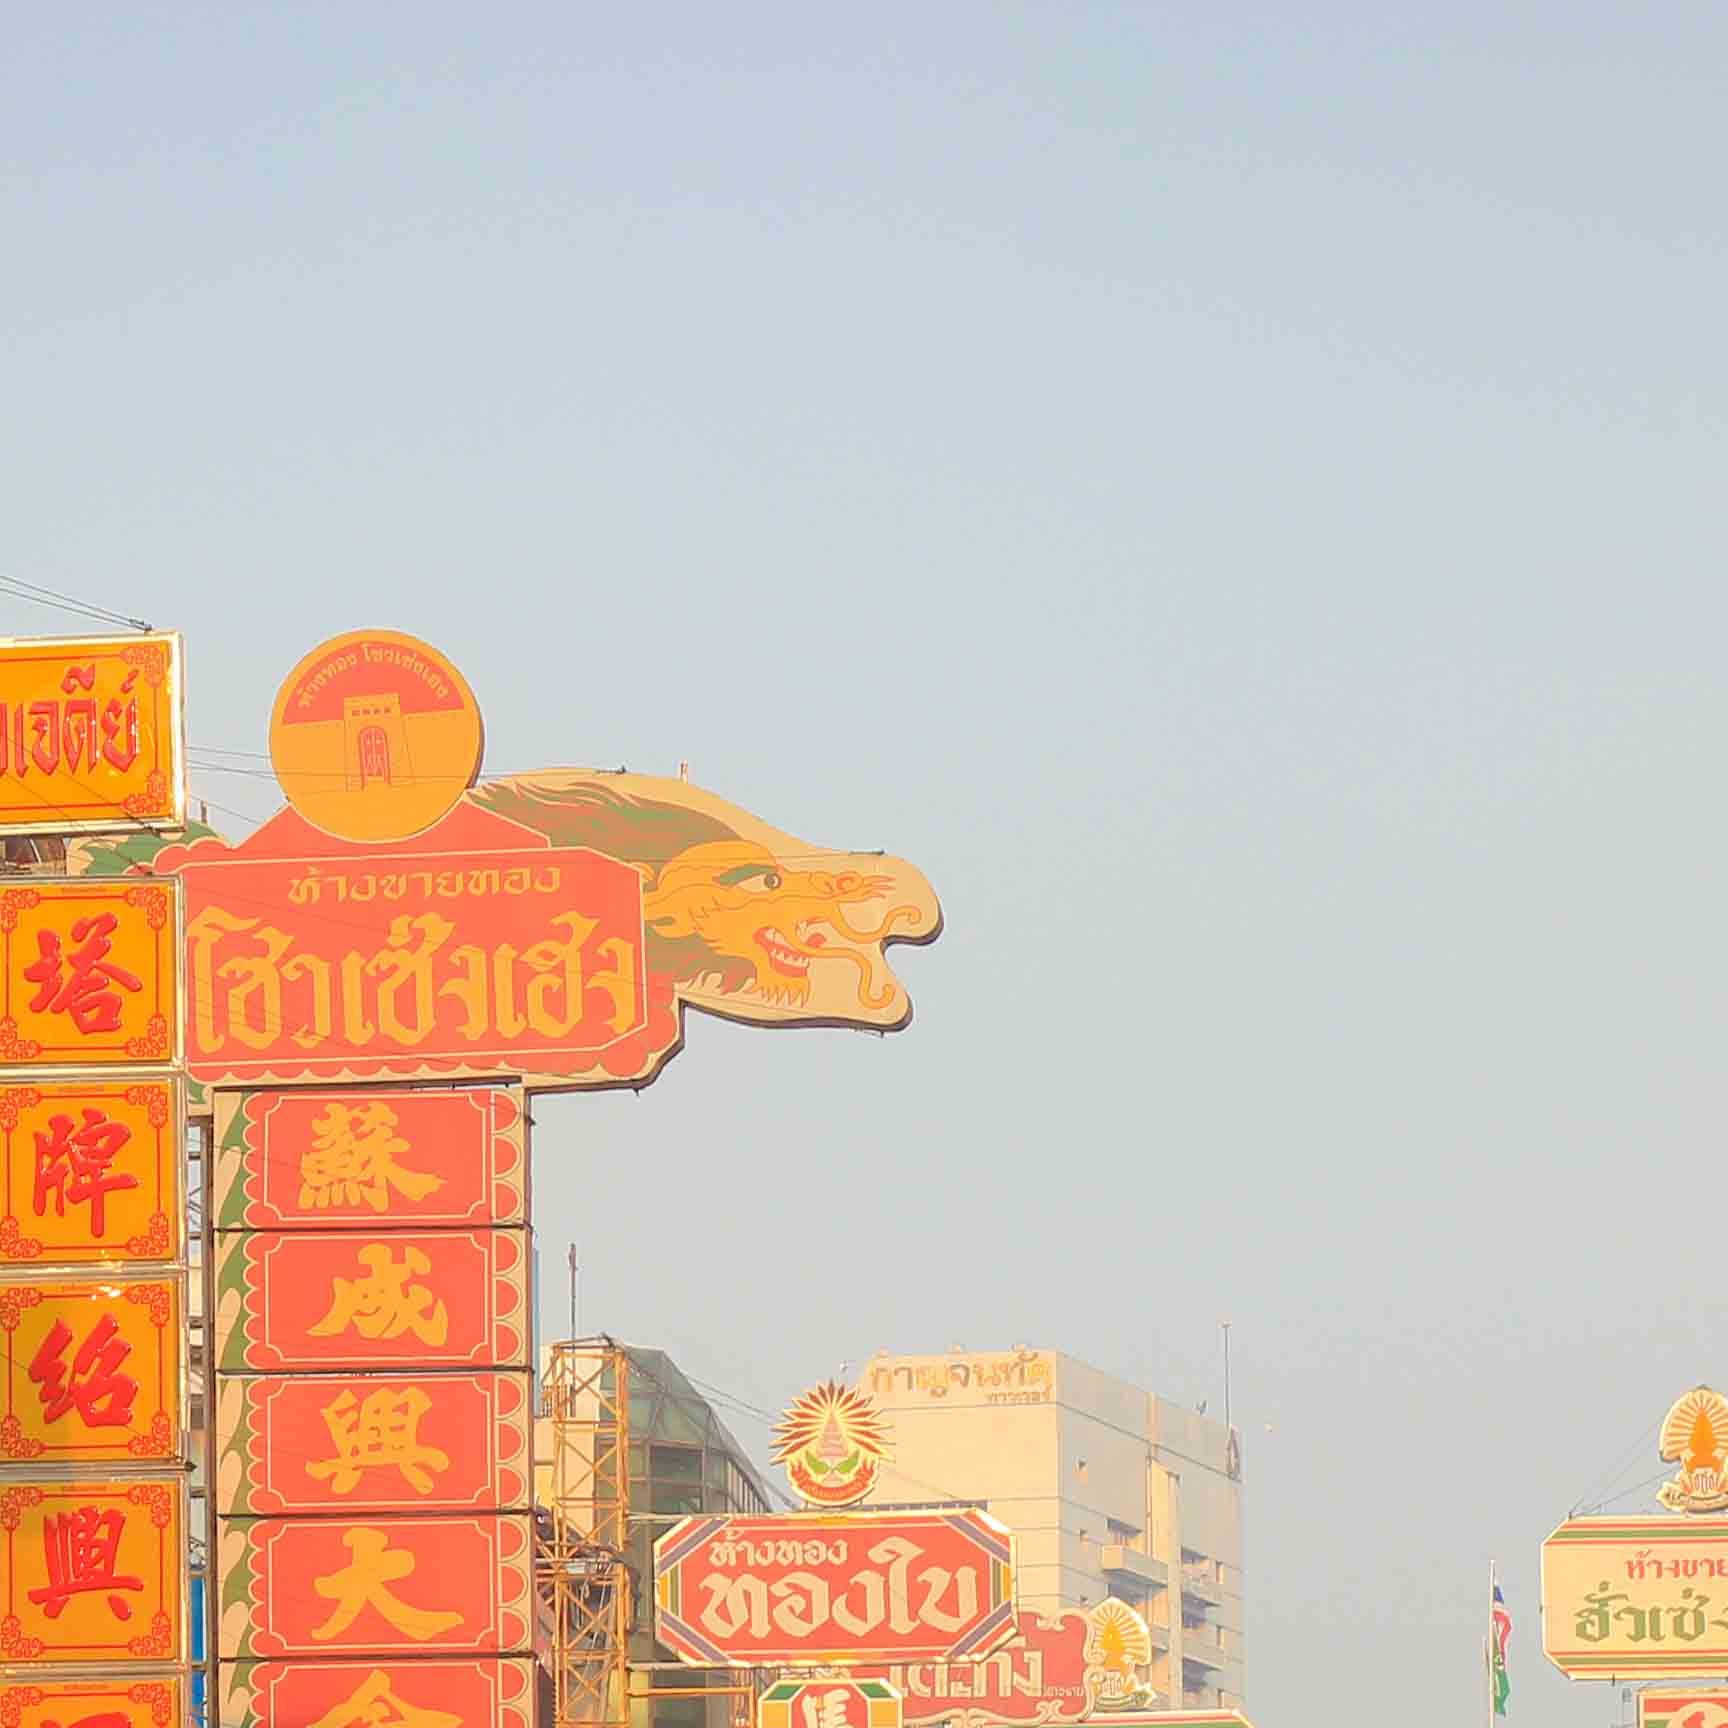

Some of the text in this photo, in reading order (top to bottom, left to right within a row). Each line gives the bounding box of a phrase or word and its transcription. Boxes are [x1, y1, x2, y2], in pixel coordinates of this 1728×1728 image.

[287, 866, 561, 905] ห้างขายทอง
[708, 1529, 848, 1567] ห้างทอง
